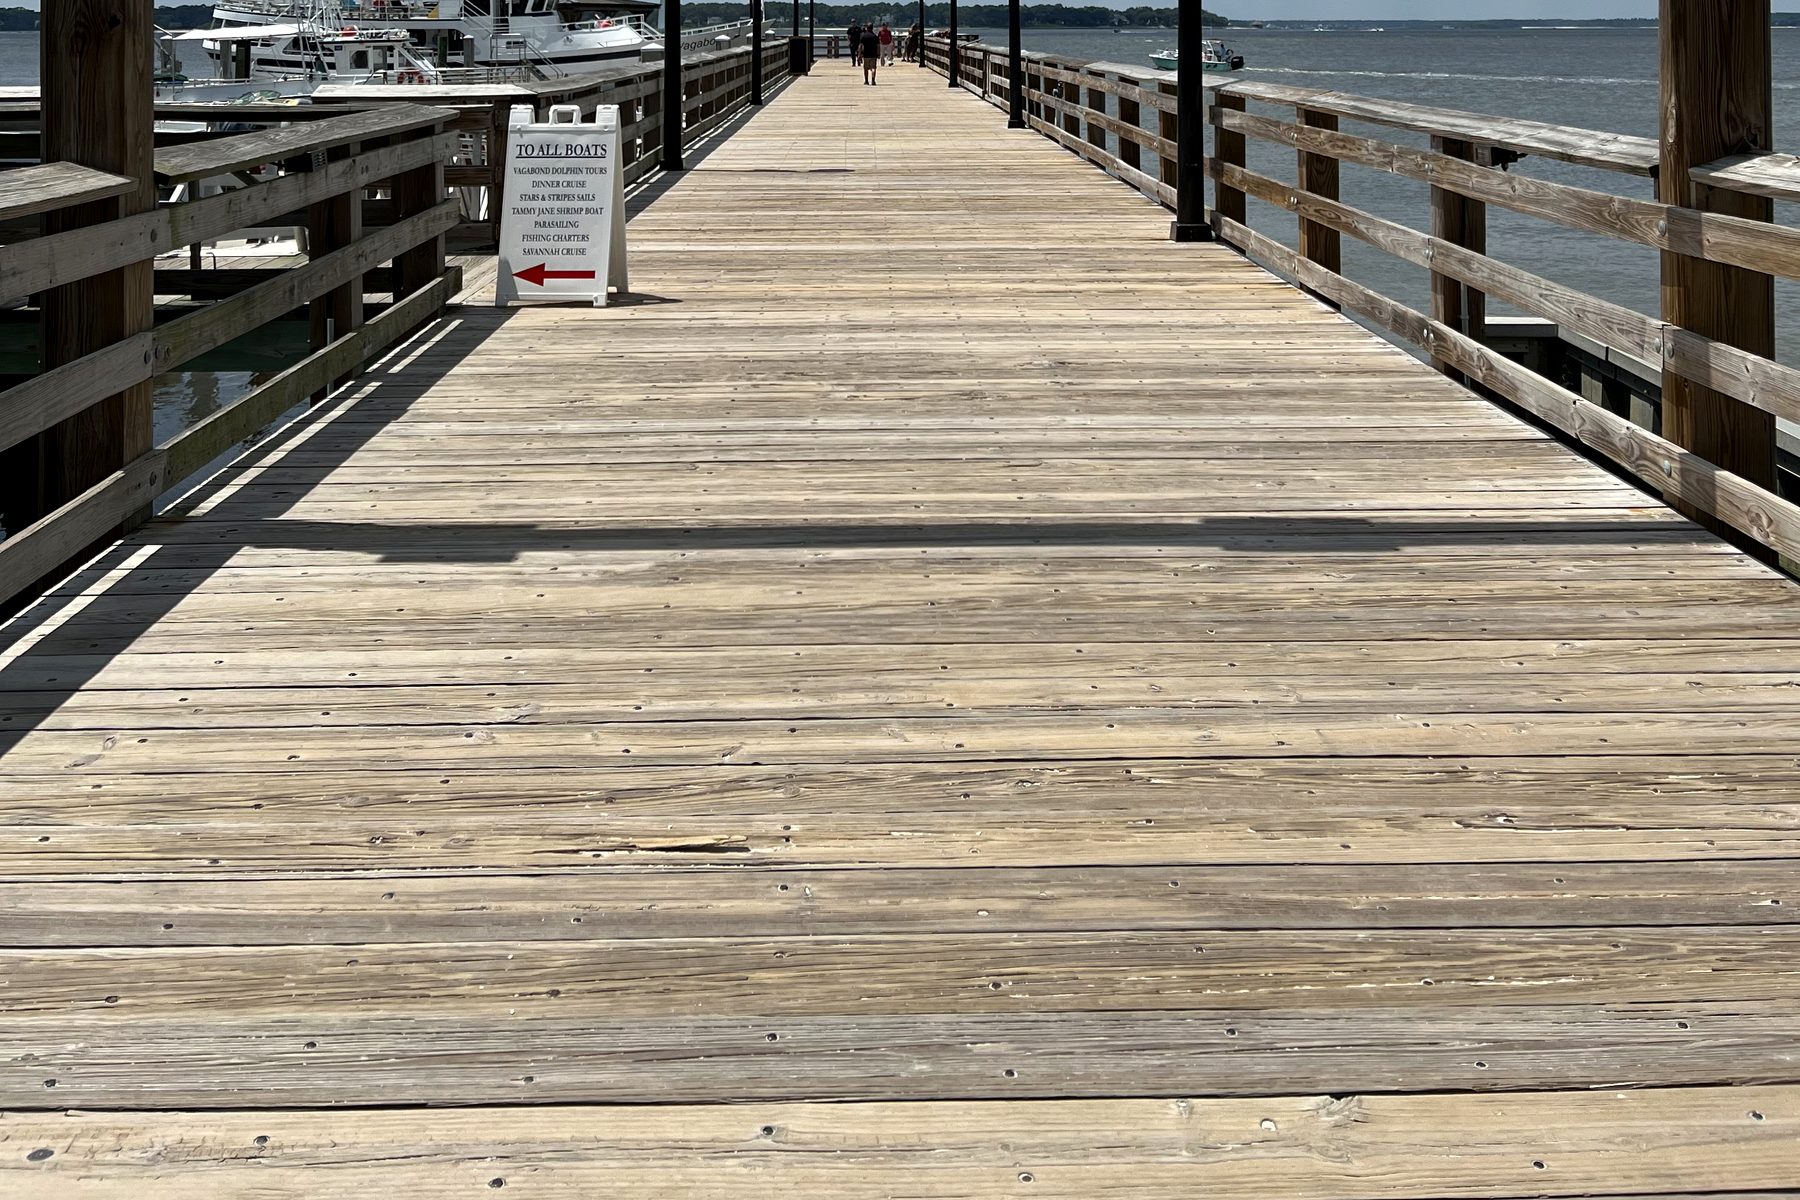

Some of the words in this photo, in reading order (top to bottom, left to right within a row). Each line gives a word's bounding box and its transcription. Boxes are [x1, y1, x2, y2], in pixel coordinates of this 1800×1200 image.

[516, 144, 535, 156] TO
[537, 144, 562, 156] ALL
[565, 143, 608, 156] BOATS
[513, 166, 551, 175] VAGABOND
[551, 166, 584, 175] DOLPHIN
[585, 166, 608, 175] TOURS
[532, 180, 560, 189] DINNER
[561, 180, 587, 189] CRUISE
[520, 193, 540, 202] STARS
[541, 193, 547, 202] &
[548, 193, 576, 202] STRIPES
[577, 193, 596, 202] SAILS
[511, 207, 536, 216] TAMMY
[536, 207, 556, 218] JANE
[556, 207, 584, 216] SHRIMP
[585, 207, 604, 216] BOAT
[533, 220, 580, 229] PARASAILING
[521, 234, 552, 243] FISHING
[552, 234, 590, 243] CHARTERS
[522, 247, 560, 256] SAVANNAH
[561, 247, 587, 256] CRUISE
